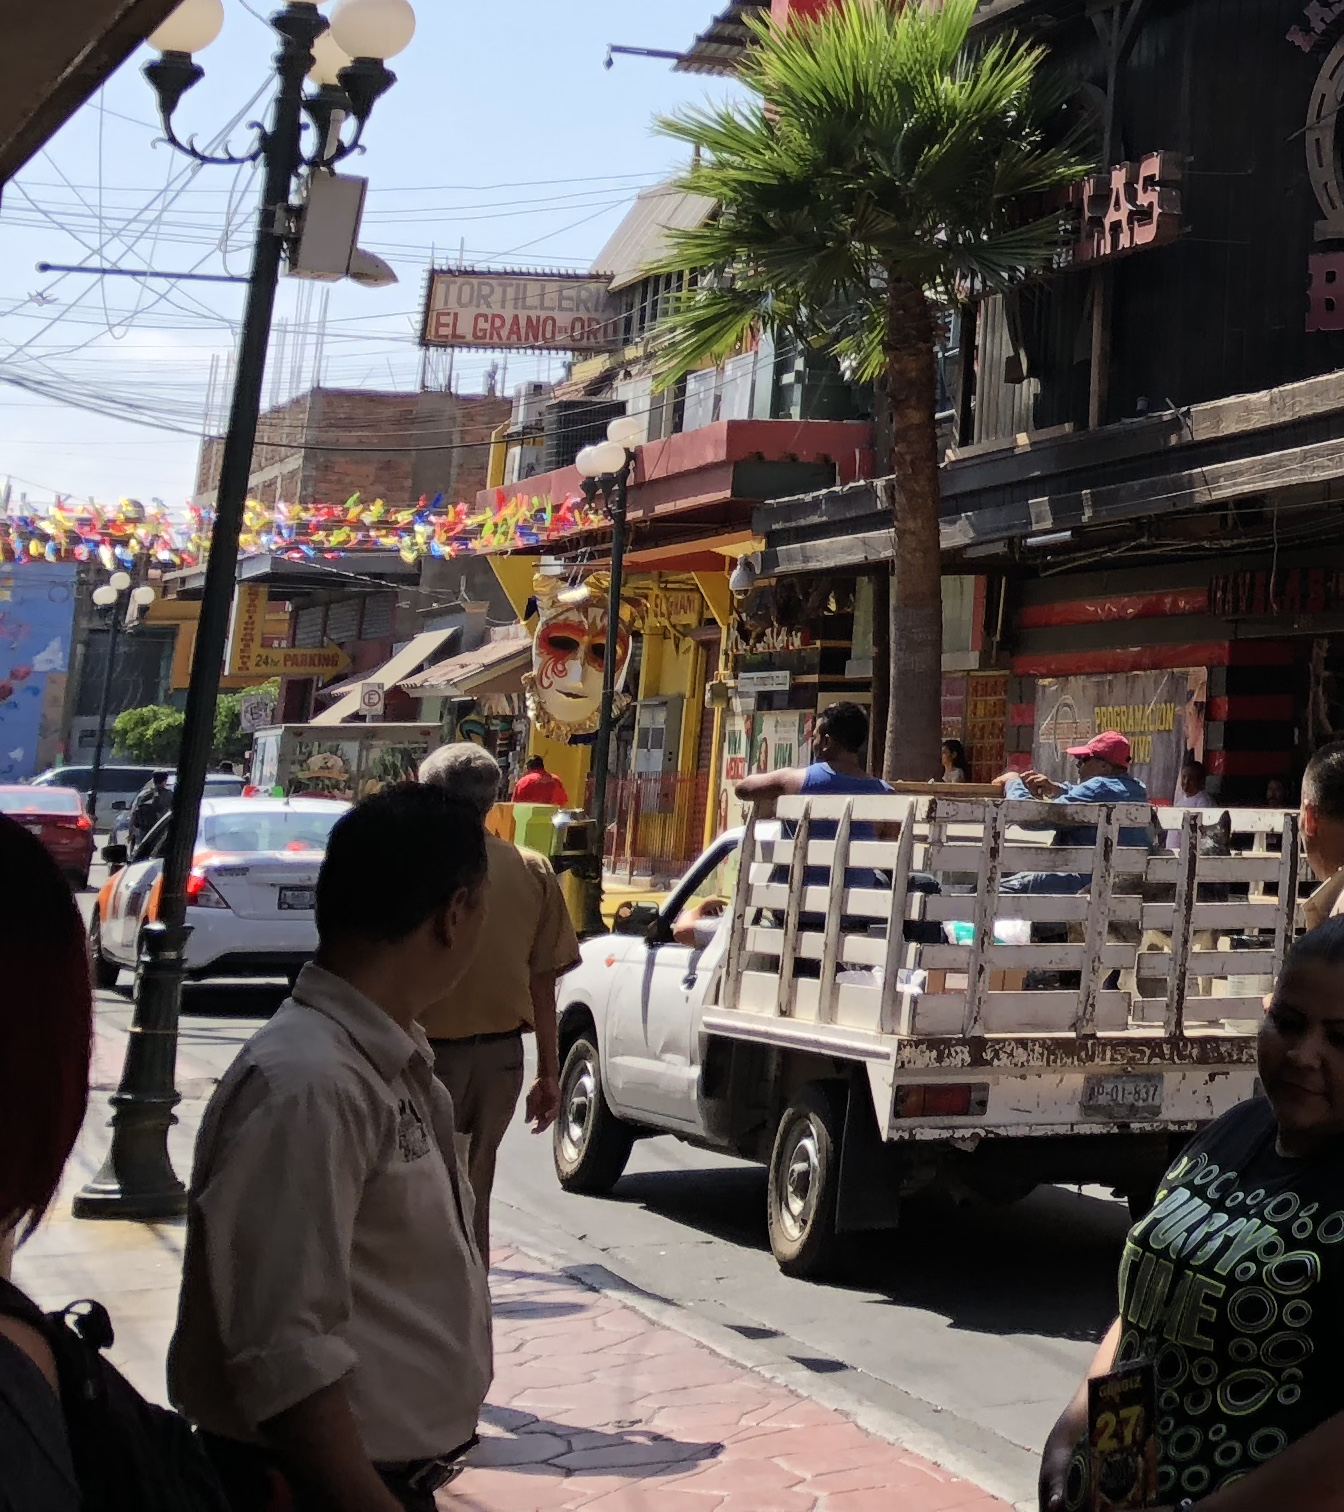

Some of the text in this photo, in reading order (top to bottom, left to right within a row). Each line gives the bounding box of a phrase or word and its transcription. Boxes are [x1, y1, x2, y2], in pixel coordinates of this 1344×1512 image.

[433, 311, 466, 341] EL
[471, 312, 556, 344] GRANO
[569, 316, 619, 345] ORO
[283, 652, 340, 668] PARKING
